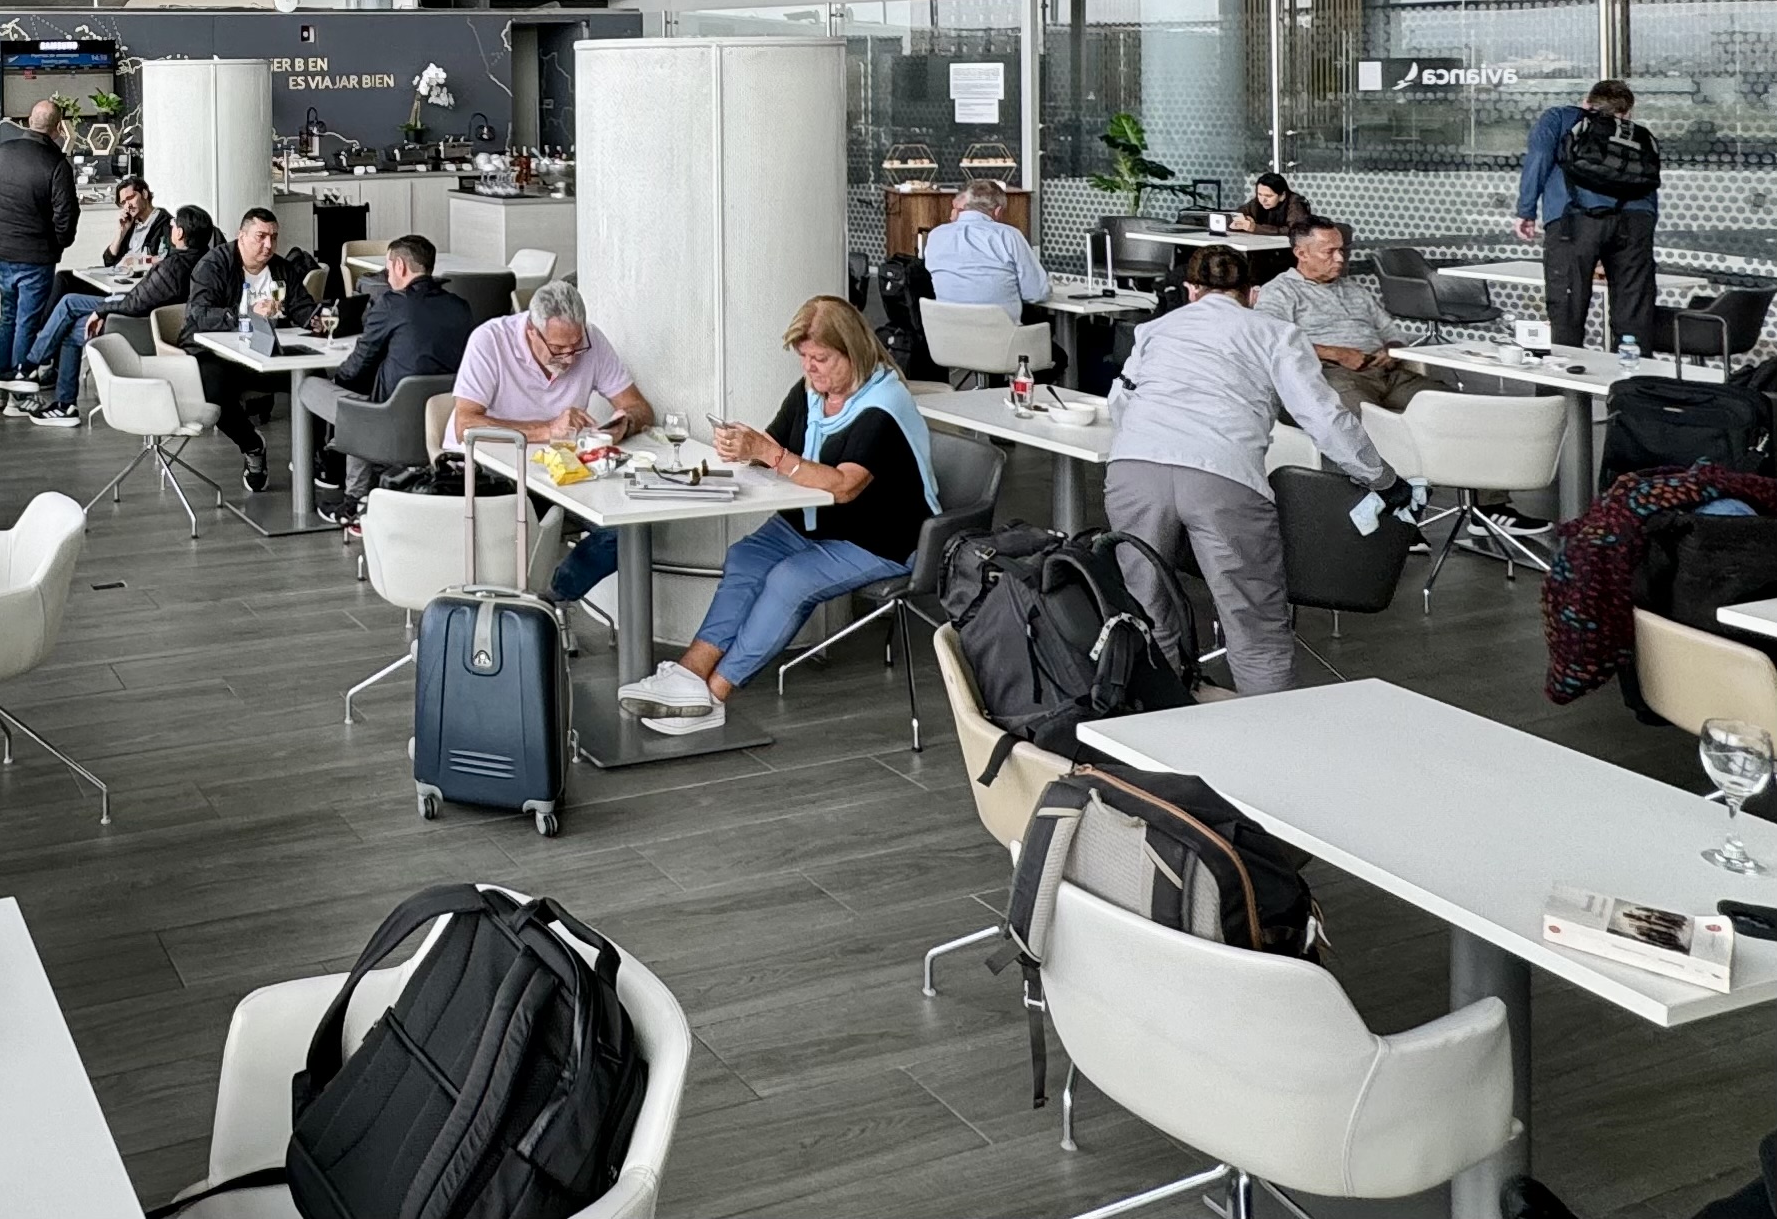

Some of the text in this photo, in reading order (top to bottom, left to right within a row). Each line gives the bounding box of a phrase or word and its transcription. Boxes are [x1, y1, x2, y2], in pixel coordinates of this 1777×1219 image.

[270, 58, 292, 72] ER
[289, 74, 395, 89] ES VIAJAR BIEN
